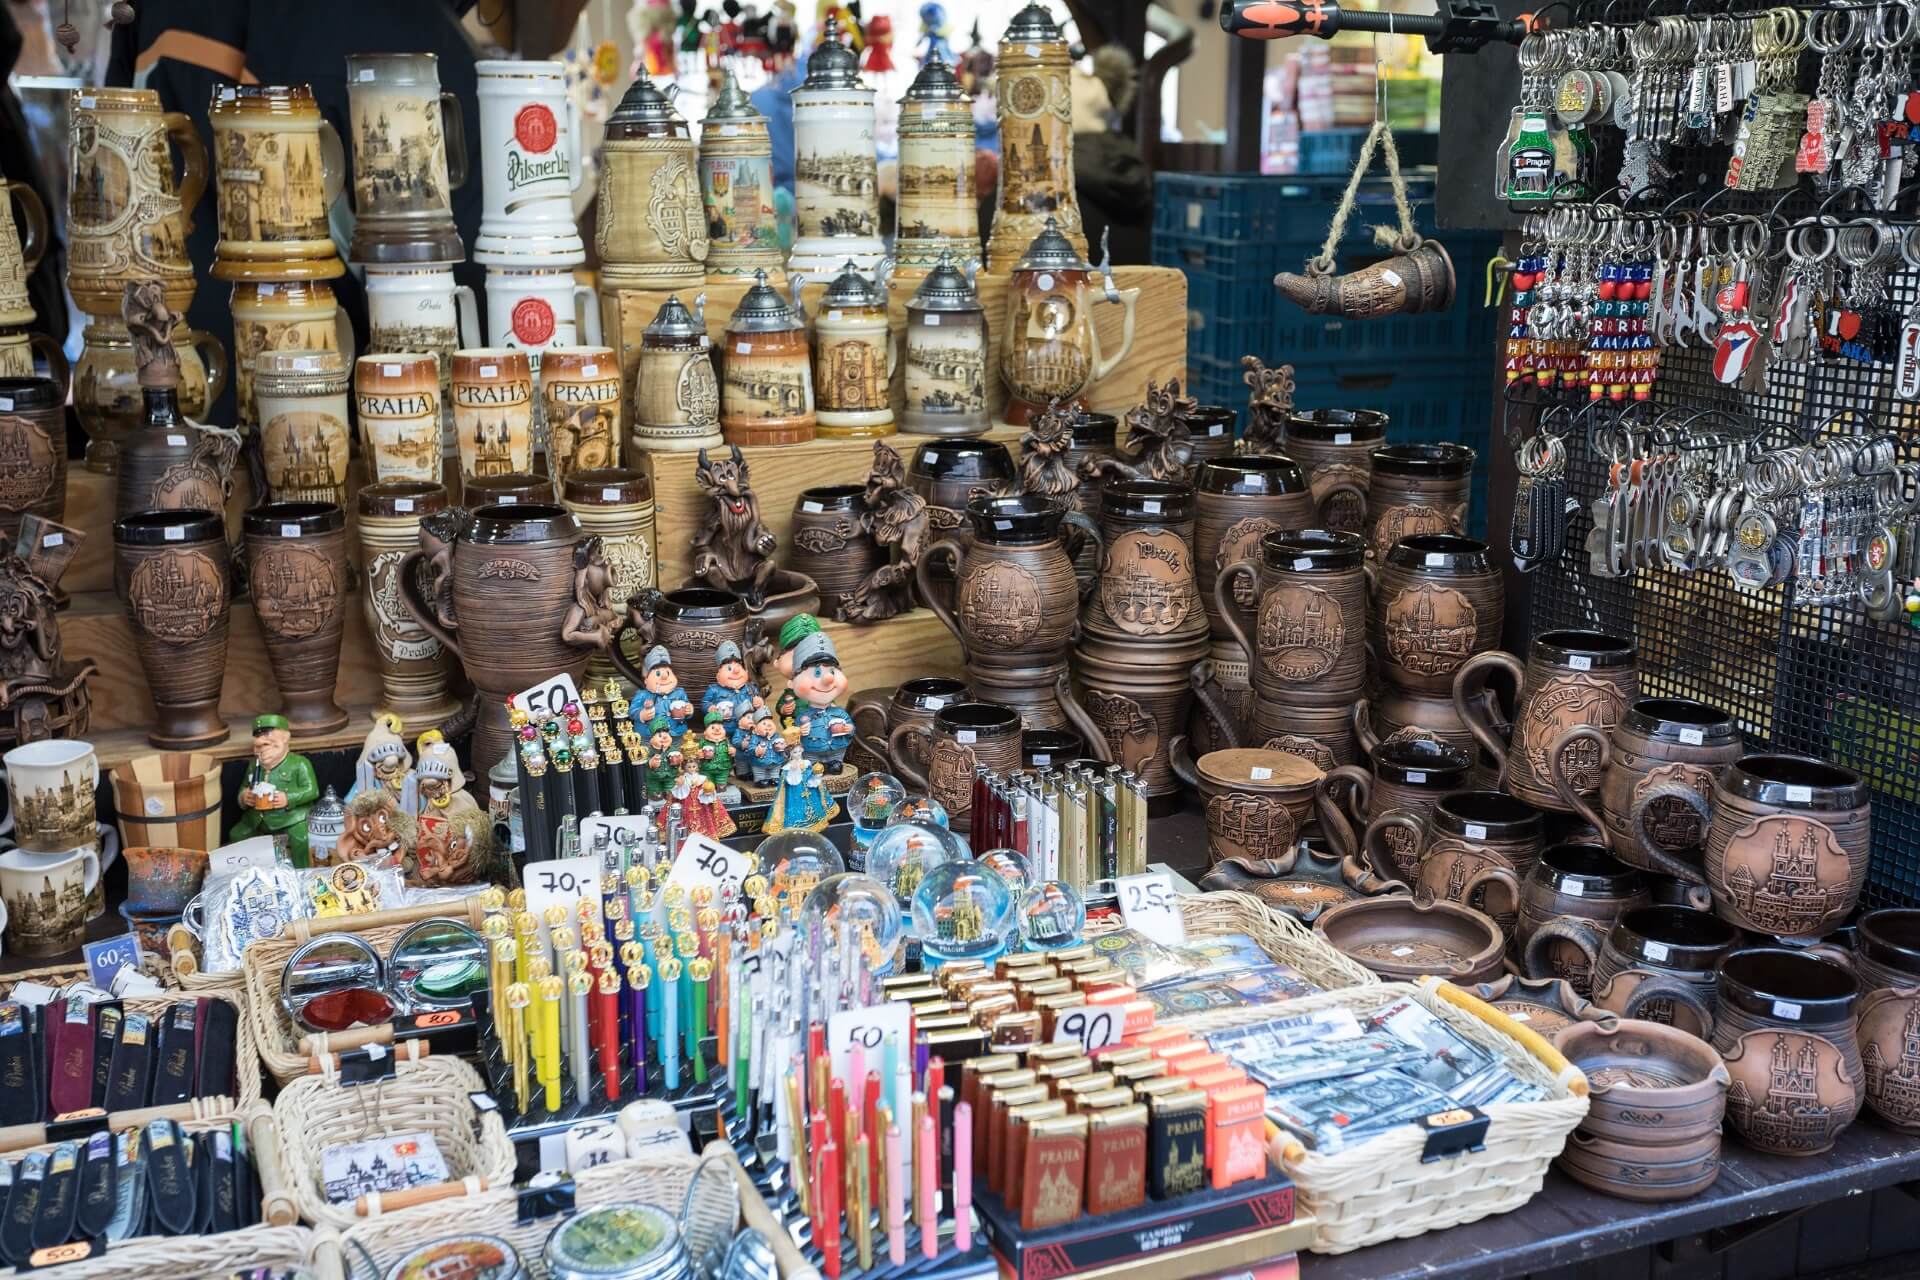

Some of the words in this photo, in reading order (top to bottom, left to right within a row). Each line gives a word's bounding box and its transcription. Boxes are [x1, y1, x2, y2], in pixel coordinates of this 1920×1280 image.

[1718, 69, 1728, 108] PRAHA
[1886, 122, 1920, 142] PRA
[508, 150, 556, 191] Pilsner
[1527, 158, 1551, 168] Prague
[457, 383, 527, 403] PRAHA
[554, 378, 619, 402] PRAHA
[359, 395, 429, 415] PRAHA
[487, 560, 528, 571] PRAHA
[1276, 663, 1323, 677] PRAHA
[1535, 687, 1578, 719] PRAHA
[538, 872, 591, 897] 70,-
[1752, 914, 1815, 932] PRAHA
[1062, 1012, 1112, 1054] 90
[1167, 1119, 1205, 1137] PRAHA
[1103, 1135, 1142, 1152] PRAHA
[1039, 1150, 1081, 1165] PRAHA
